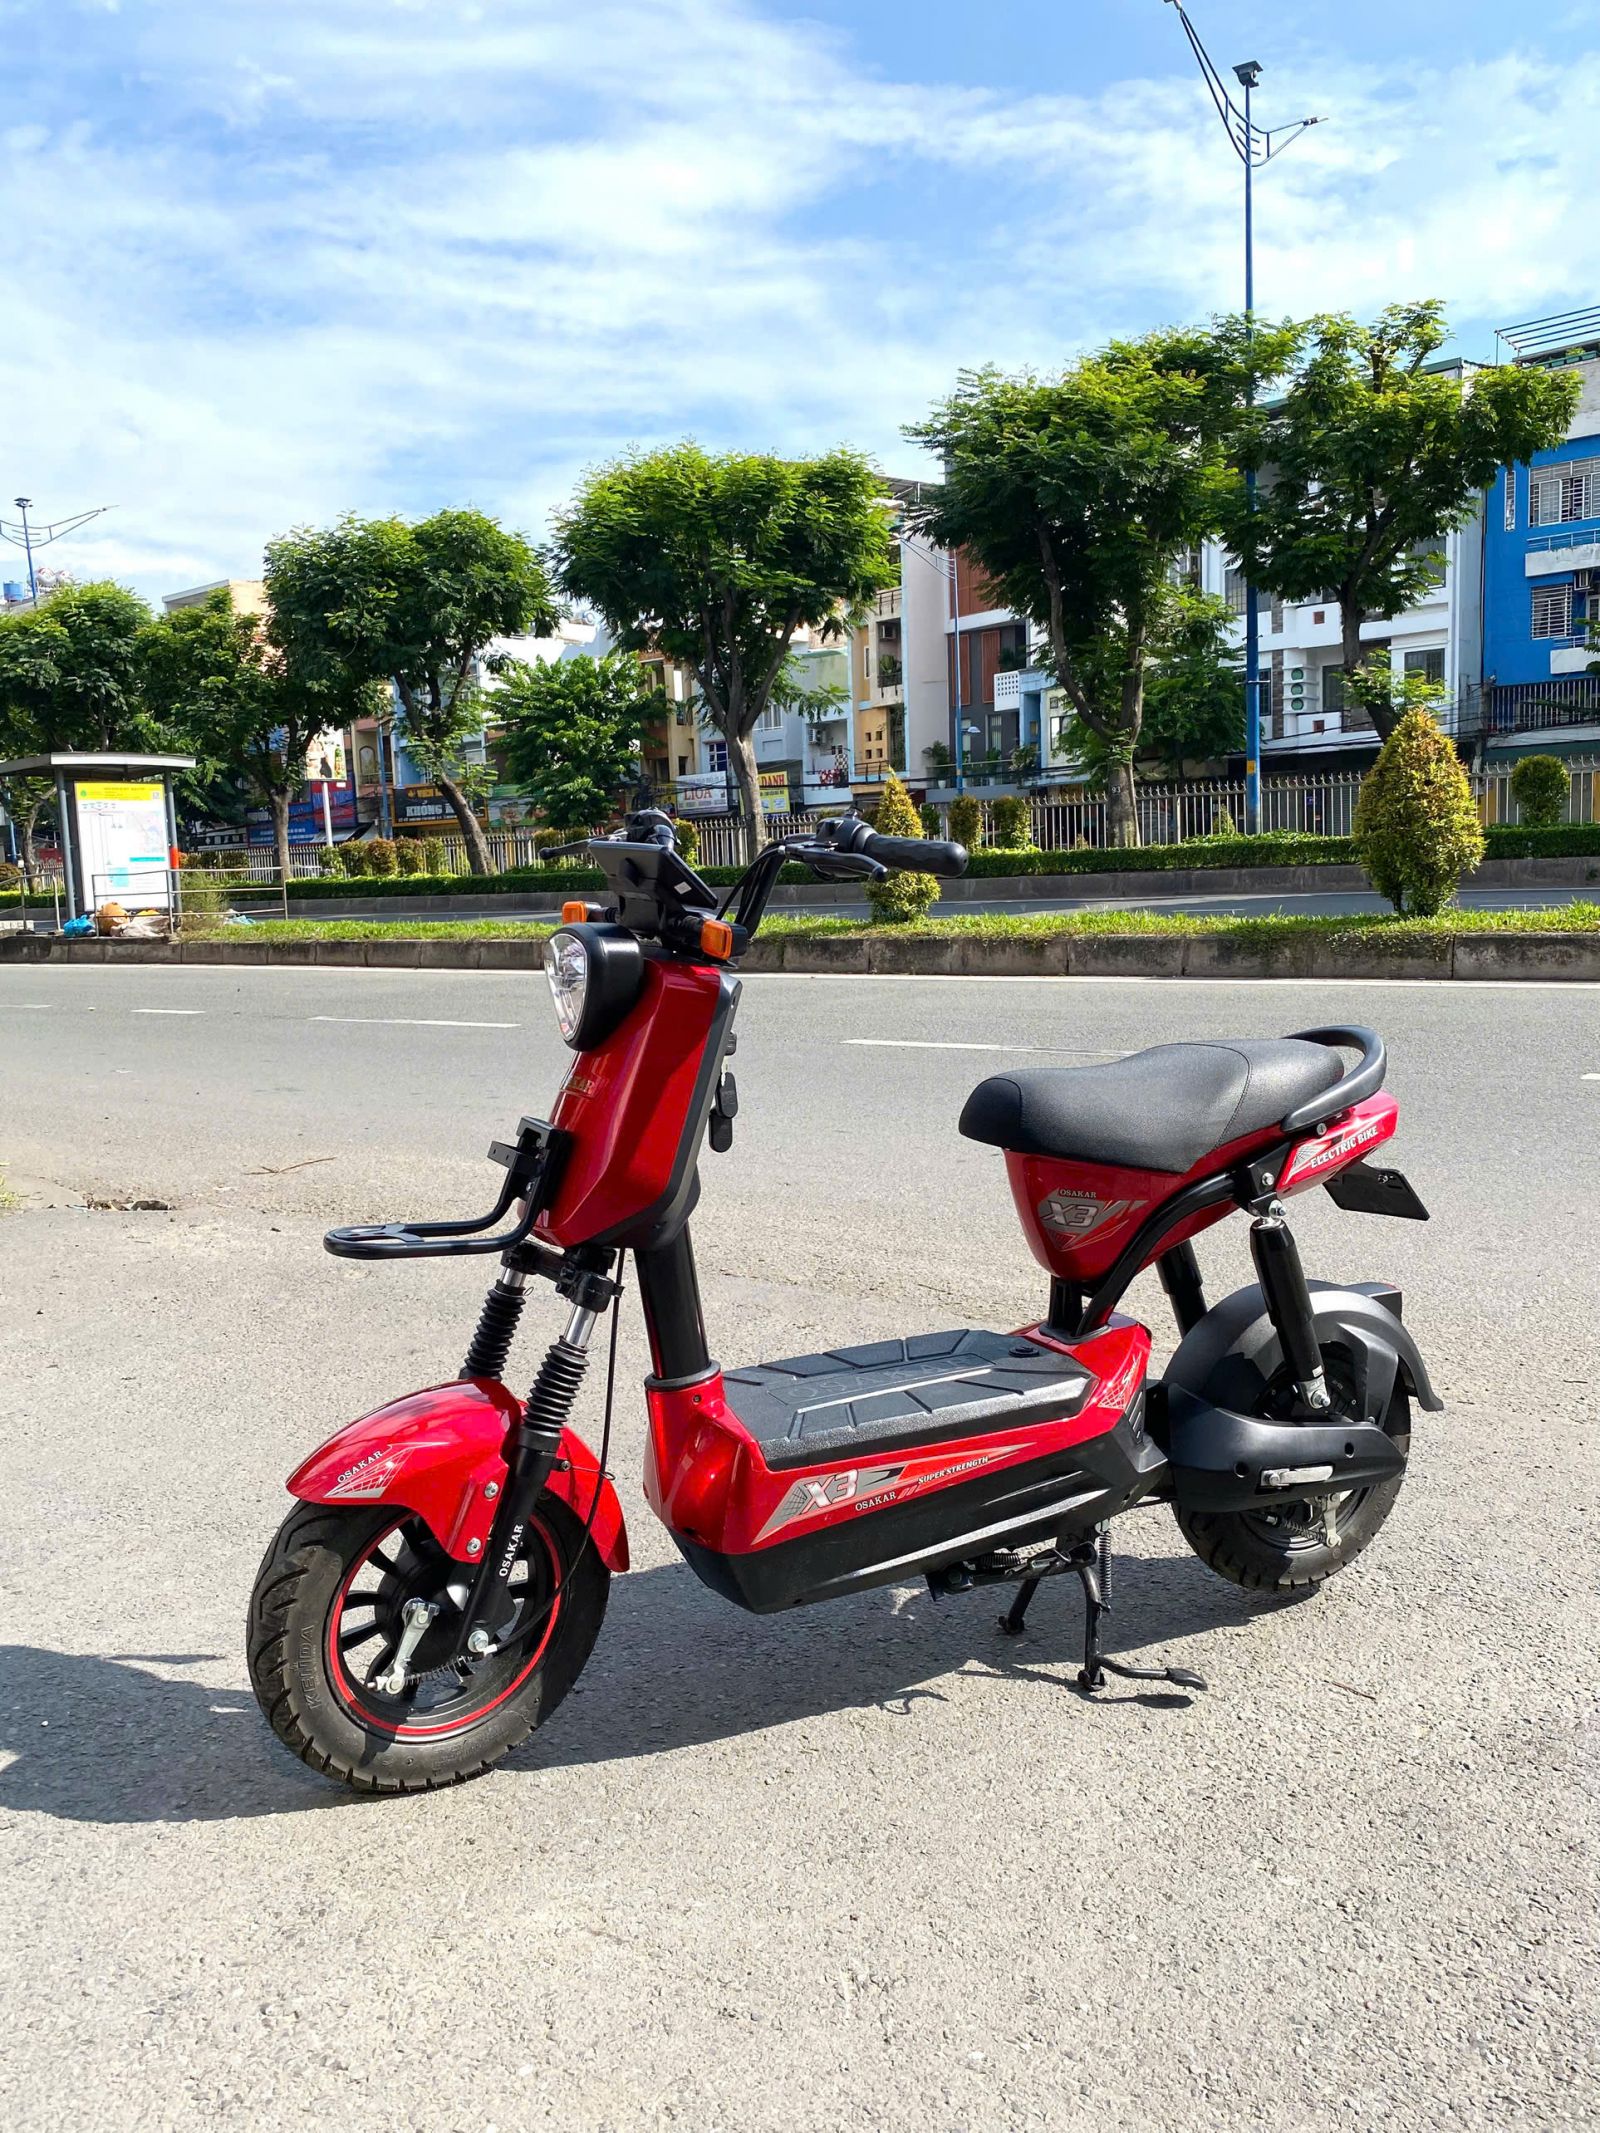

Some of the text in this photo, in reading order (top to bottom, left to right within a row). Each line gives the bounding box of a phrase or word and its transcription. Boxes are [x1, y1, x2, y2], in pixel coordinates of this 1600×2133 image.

[1310, 1125, 1379, 1169] ELECTRIC BIKE
[1060, 1189, 1097, 1198] OSAKAR
[1040, 1200, 1098, 1227] X3
[337, 1450, 383, 1484] OSAKAR
[918, 1456, 989, 1484] SUPER STRENGTH
[801, 1468, 859, 1514] X3
[855, 1491, 896, 1511] OSAKAR
[498, 1524, 524, 1577] OSAKAR
[299, 1624, 321, 1710] KENDA
